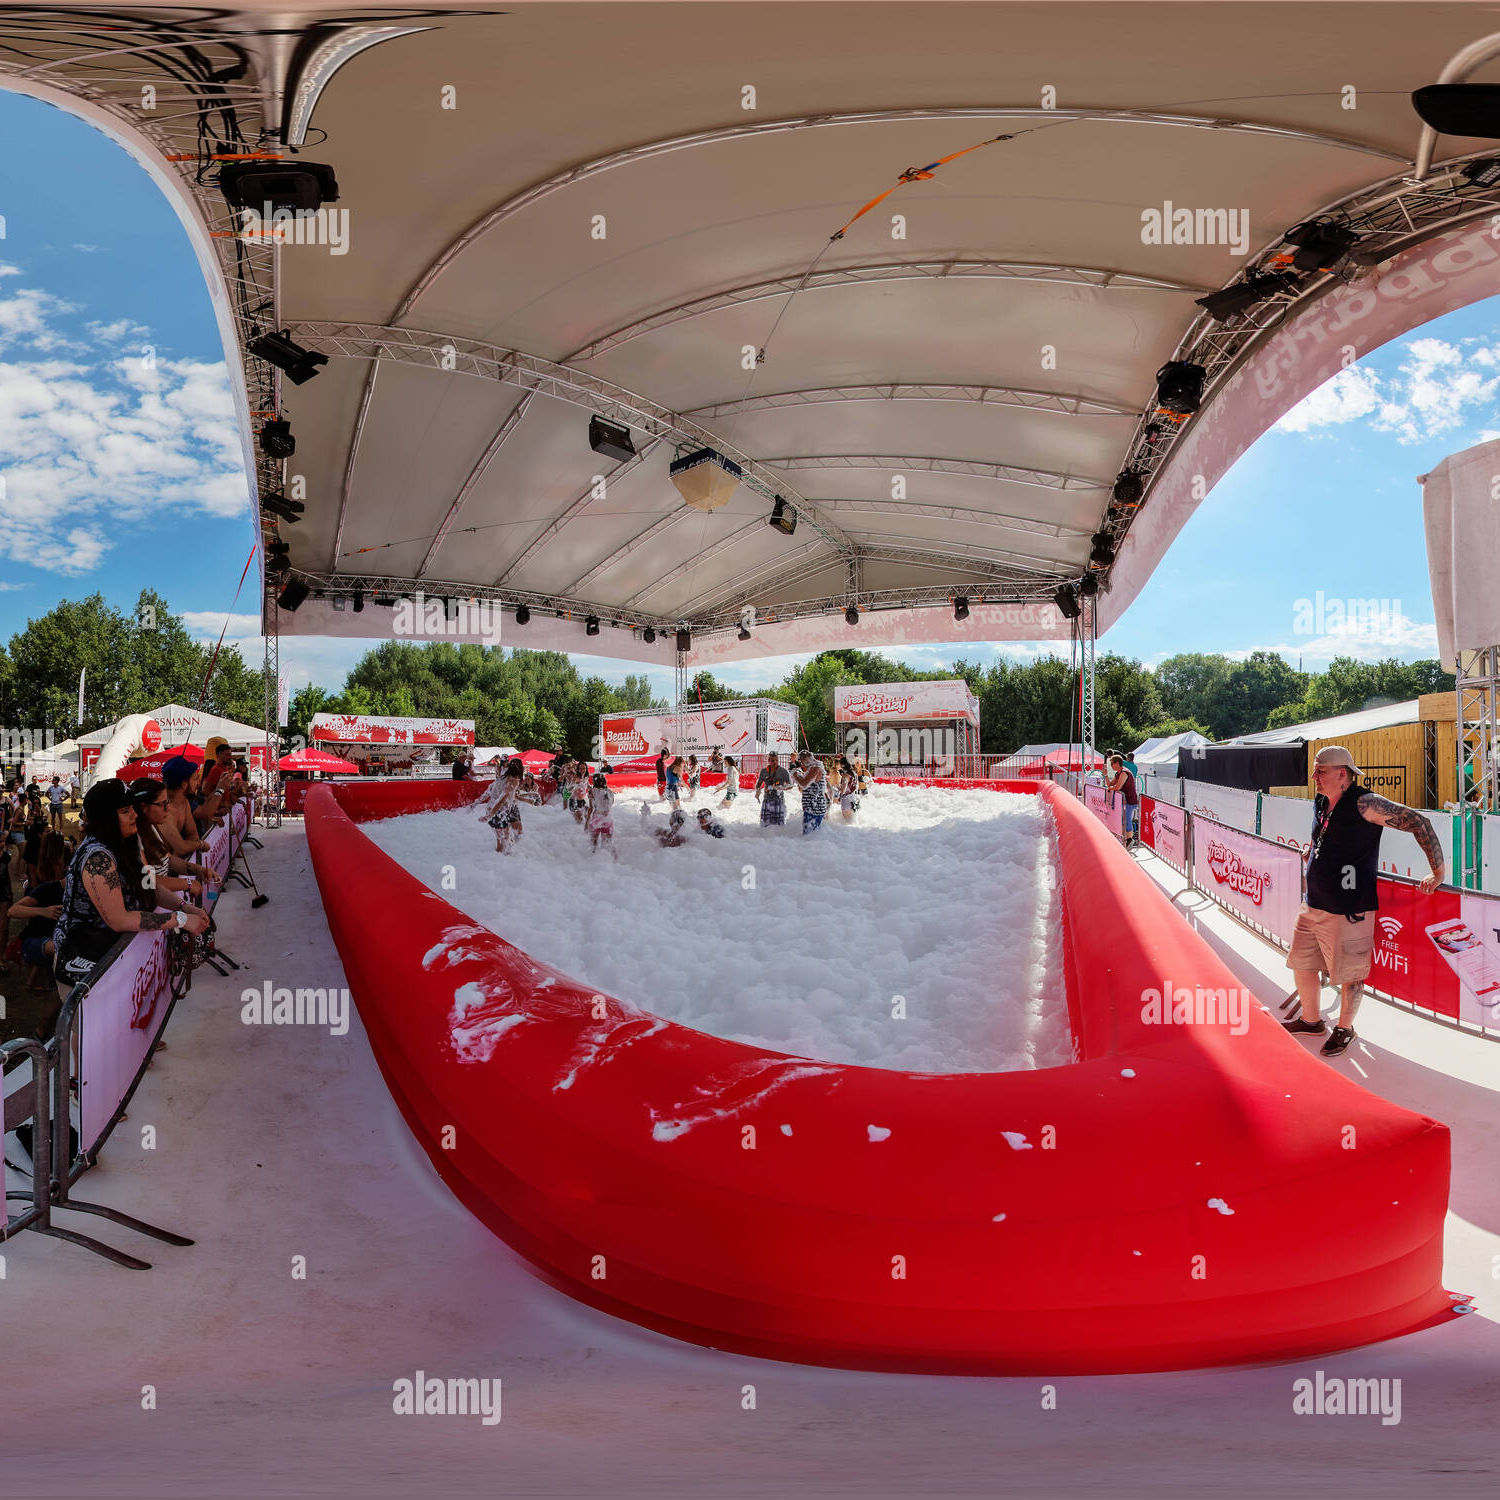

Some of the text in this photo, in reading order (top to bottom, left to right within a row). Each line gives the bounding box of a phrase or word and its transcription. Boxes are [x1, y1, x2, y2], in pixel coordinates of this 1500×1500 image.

[872, 698, 908, 714] crazy
[322, 721, 368, 731] Cocktail
[423, 725, 465, 735] Cocktail
[337, 730, 359, 740] Bar
[436, 733, 456, 743] Bar
[606, 730, 642, 743] Beauty
[616, 741, 645, 754] point
[1362, 772, 1402, 791] group
[1207, 840, 1226, 864] fresh
[1229, 872, 1263, 906] crazy
[1381, 939, 1400, 952] FREE
[72, 956, 97, 969] NIKE
[1373, 946, 1409, 975] WiFi
